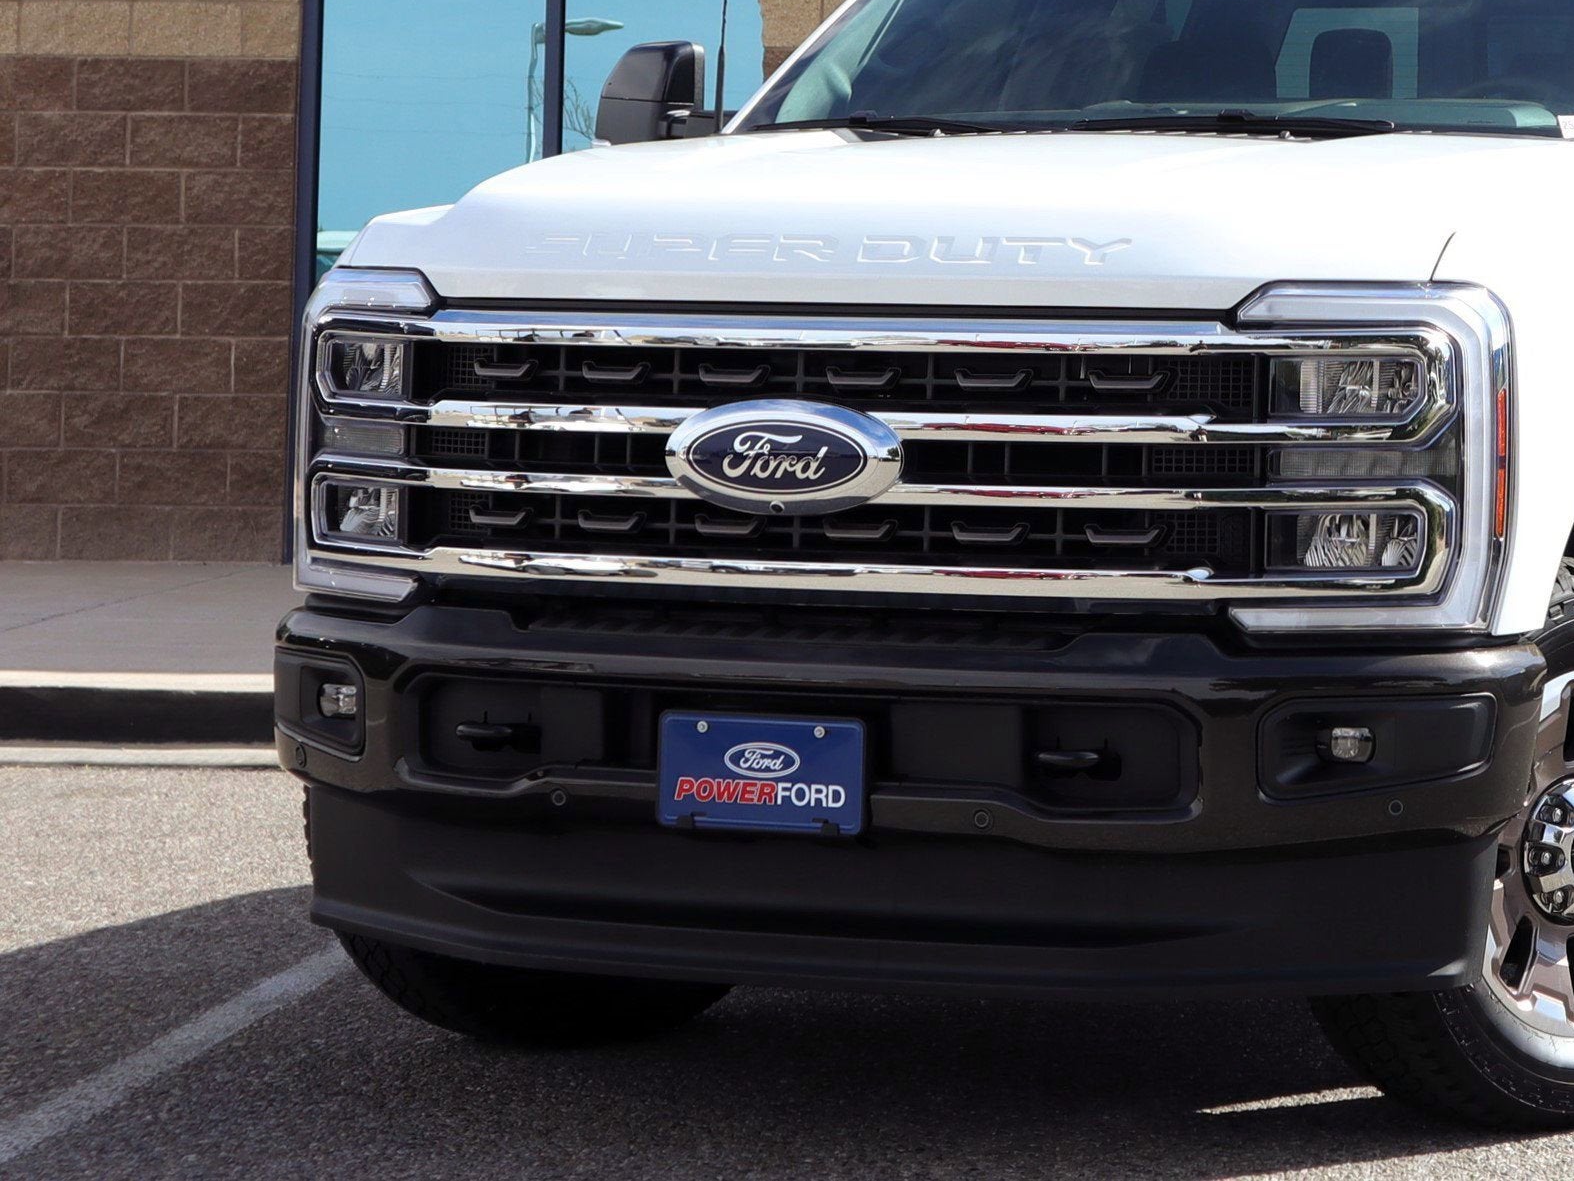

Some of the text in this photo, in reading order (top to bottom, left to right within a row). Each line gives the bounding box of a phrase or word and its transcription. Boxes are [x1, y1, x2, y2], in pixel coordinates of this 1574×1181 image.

[524, 232, 1133, 266] SUPER DUTY
[722, 431, 829, 480] Ford
[739, 748, 785, 772] Ford
